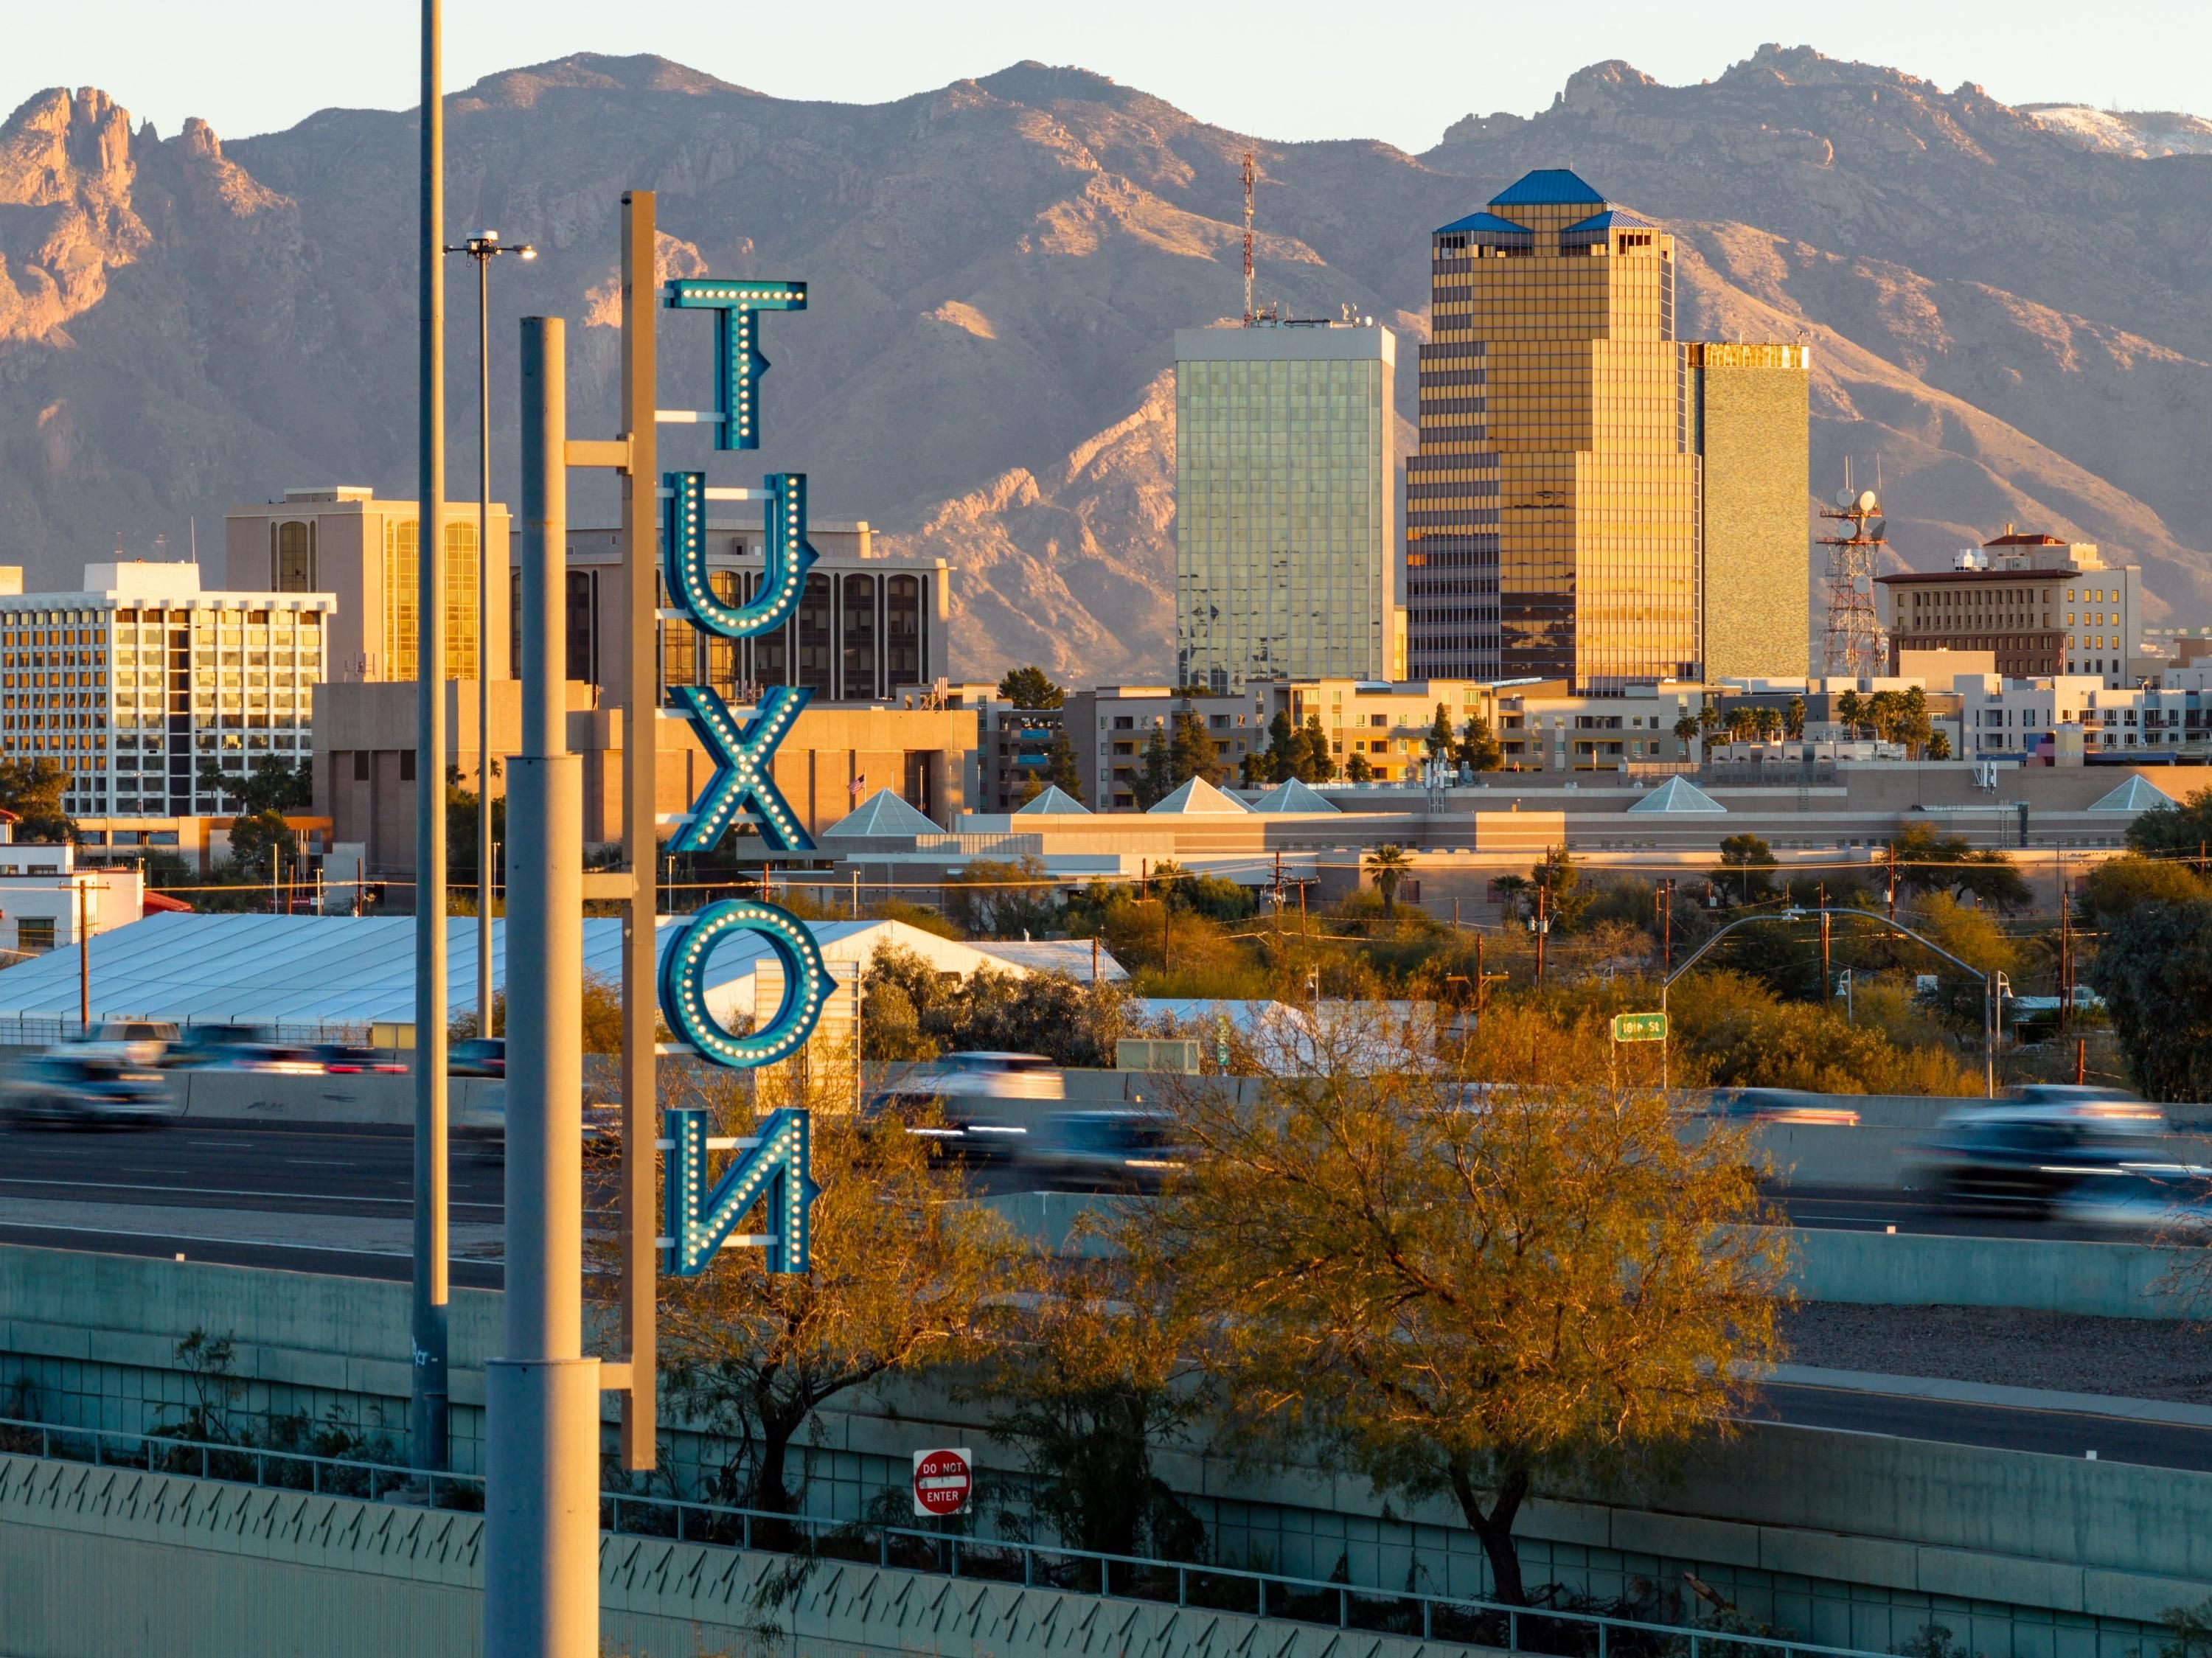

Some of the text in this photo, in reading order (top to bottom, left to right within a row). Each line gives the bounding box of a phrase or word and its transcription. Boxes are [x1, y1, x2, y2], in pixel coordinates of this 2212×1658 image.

[1623, 1022, 1659, 1033] 18th St
[923, 1463, 962, 1474] DO NOT
[927, 1491, 959, 1502] ENTER
